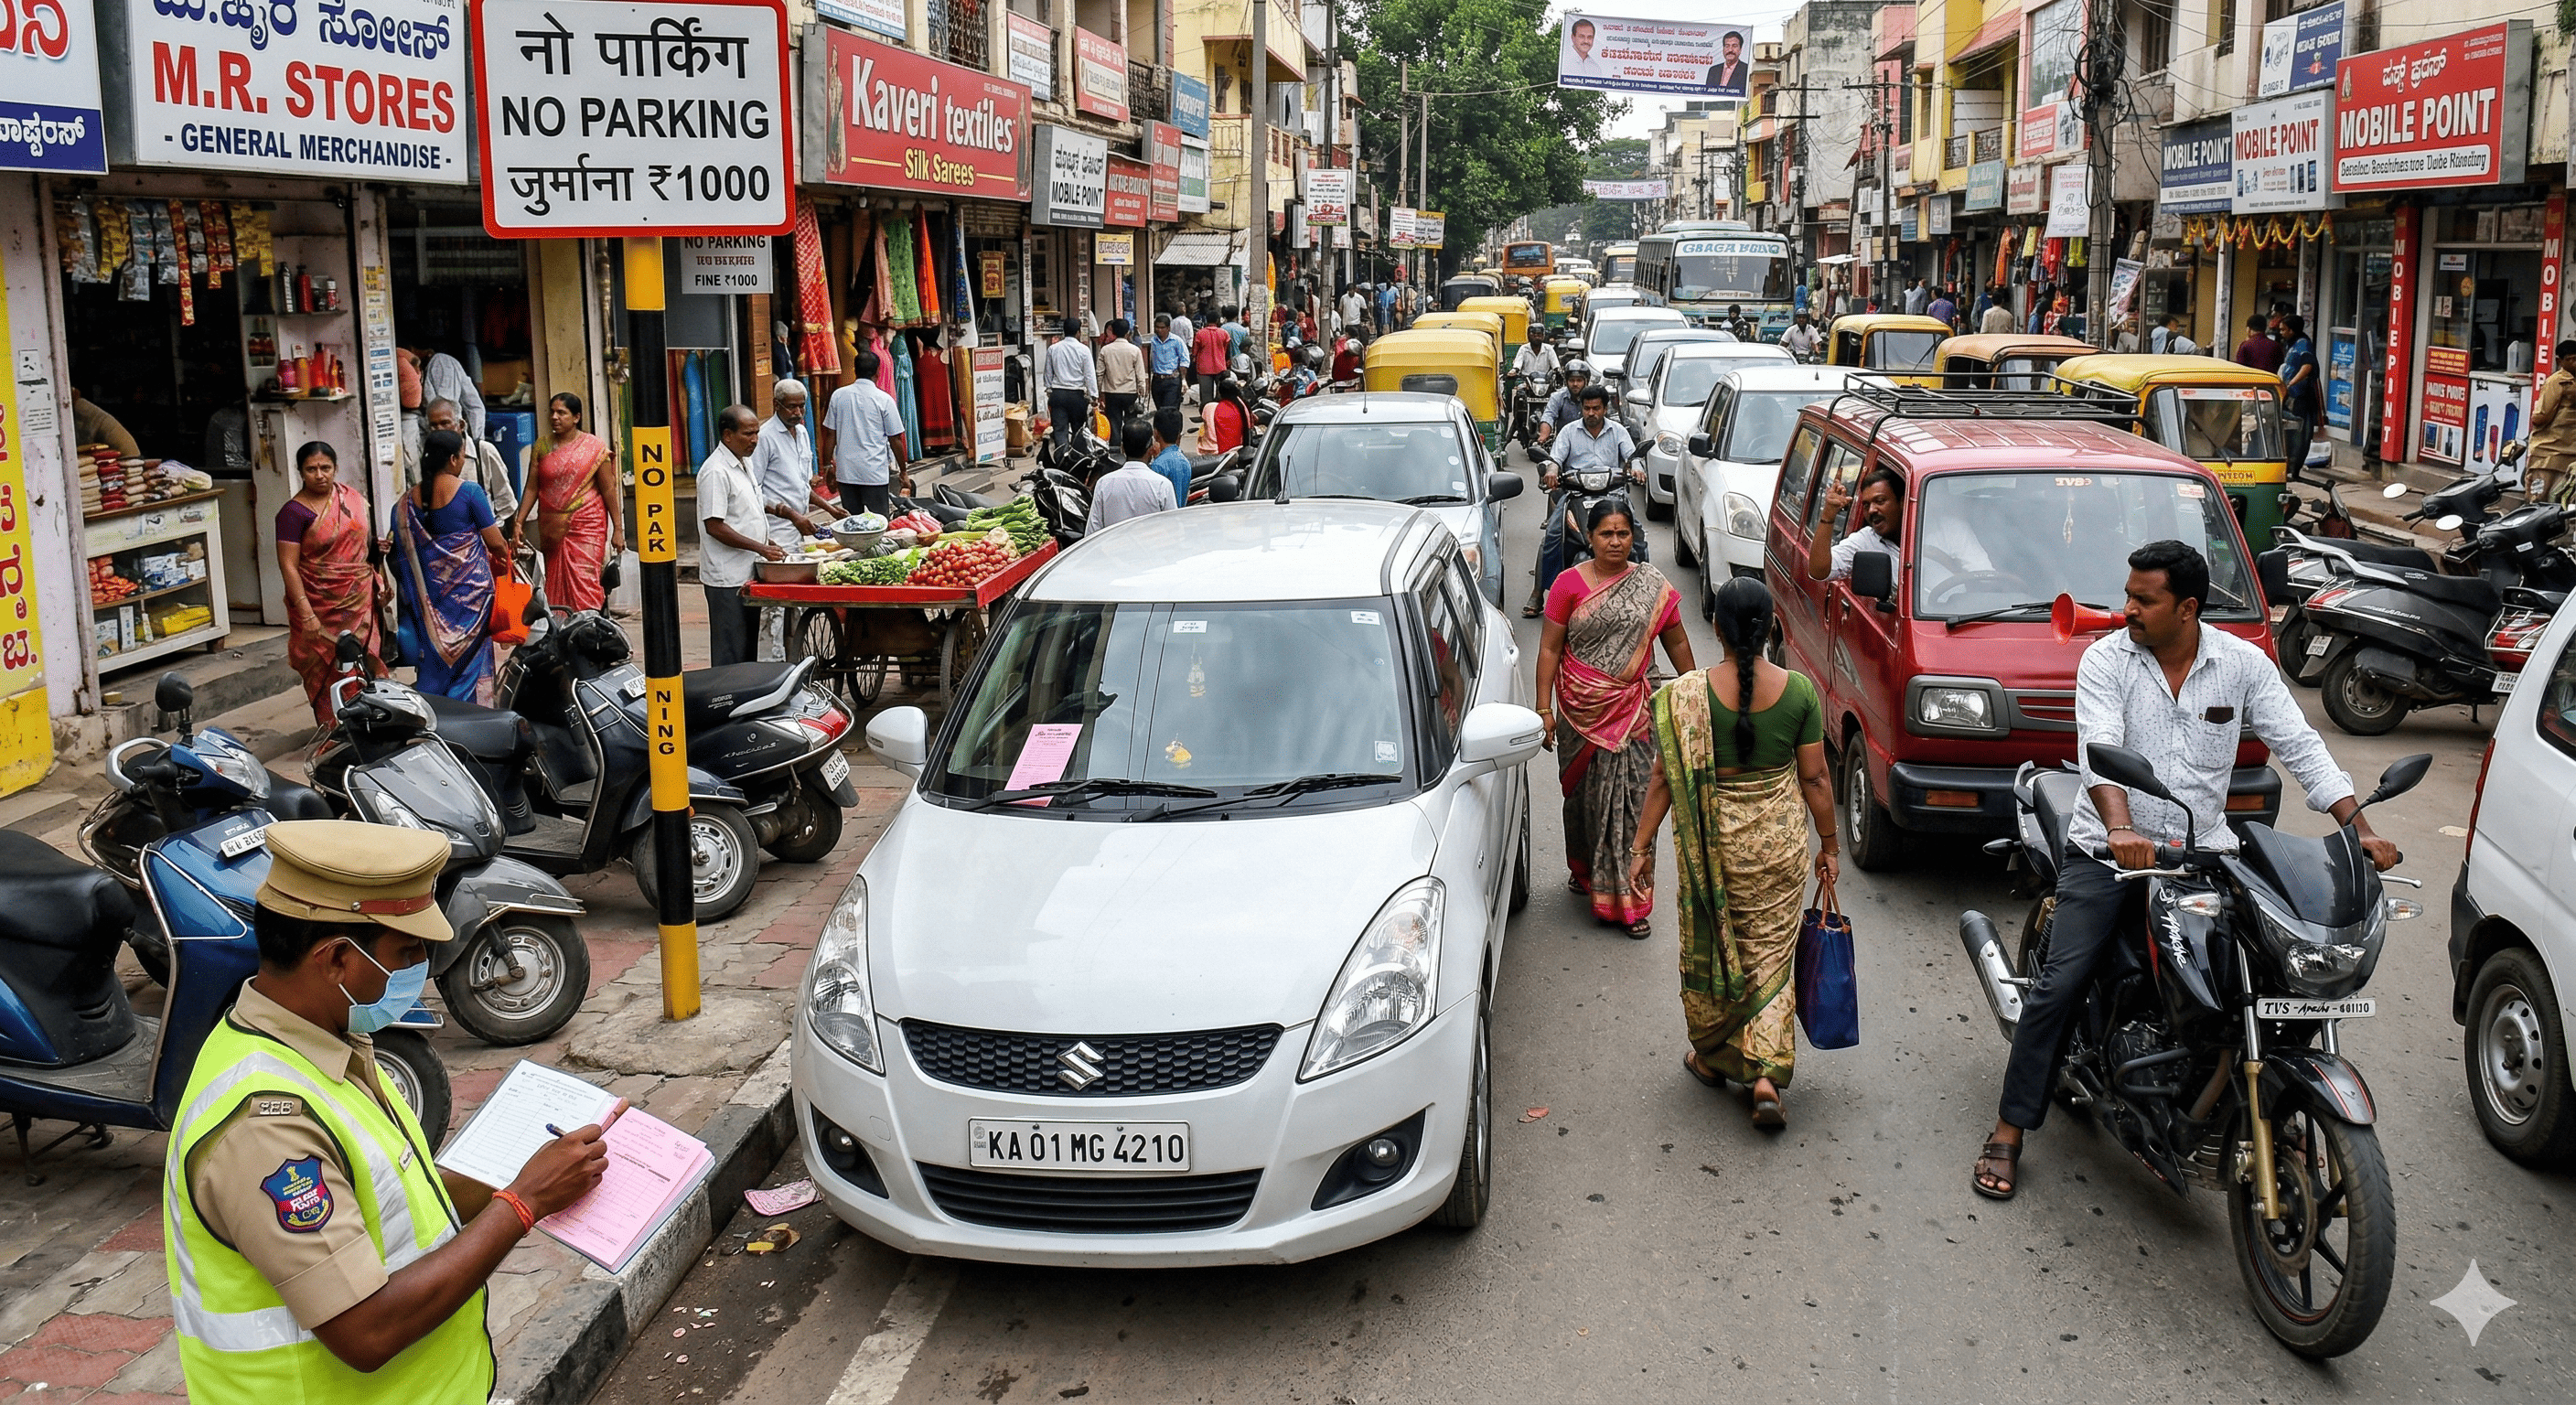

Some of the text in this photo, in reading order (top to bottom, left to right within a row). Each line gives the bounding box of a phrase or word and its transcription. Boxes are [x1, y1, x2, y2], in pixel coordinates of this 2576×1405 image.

[515, 11, 574, 75] नो
[595, 16, 749, 79] पार्किंग
[153, 40, 456, 134] M.R. STORES
[852, 54, 939, 140] Kaveri
[945, 94, 1014, 153] textiles
[502, 96, 769, 139] NO PARKING
[2339, 87, 2496, 150] MOBILE POINT
[181, 123, 292, 159] GENERAL
[300, 134, 441, 169] MERCHANDISE
[2163, 136, 2231, 171] MOBILE POINT
[2235, 119, 2319, 161] MOBILE POINT
[507, 153, 770, 216] जुर्माना ₹1000
[905, 148, 974, 186] Silk Sarees
[1051, 180, 1080, 205] MOBILE
[1081, 185, 1103, 208] POINT
[684, 235, 766, 249] NO PARKING
[695, 273, 757, 286] FINE ₹1000
[641, 444, 666, 487] NO
[656, 690, 676, 756] NING
[2264, 1002, 2291, 1014] TVS
[988, 1131, 1185, 1164] KA 01 MG 4210
